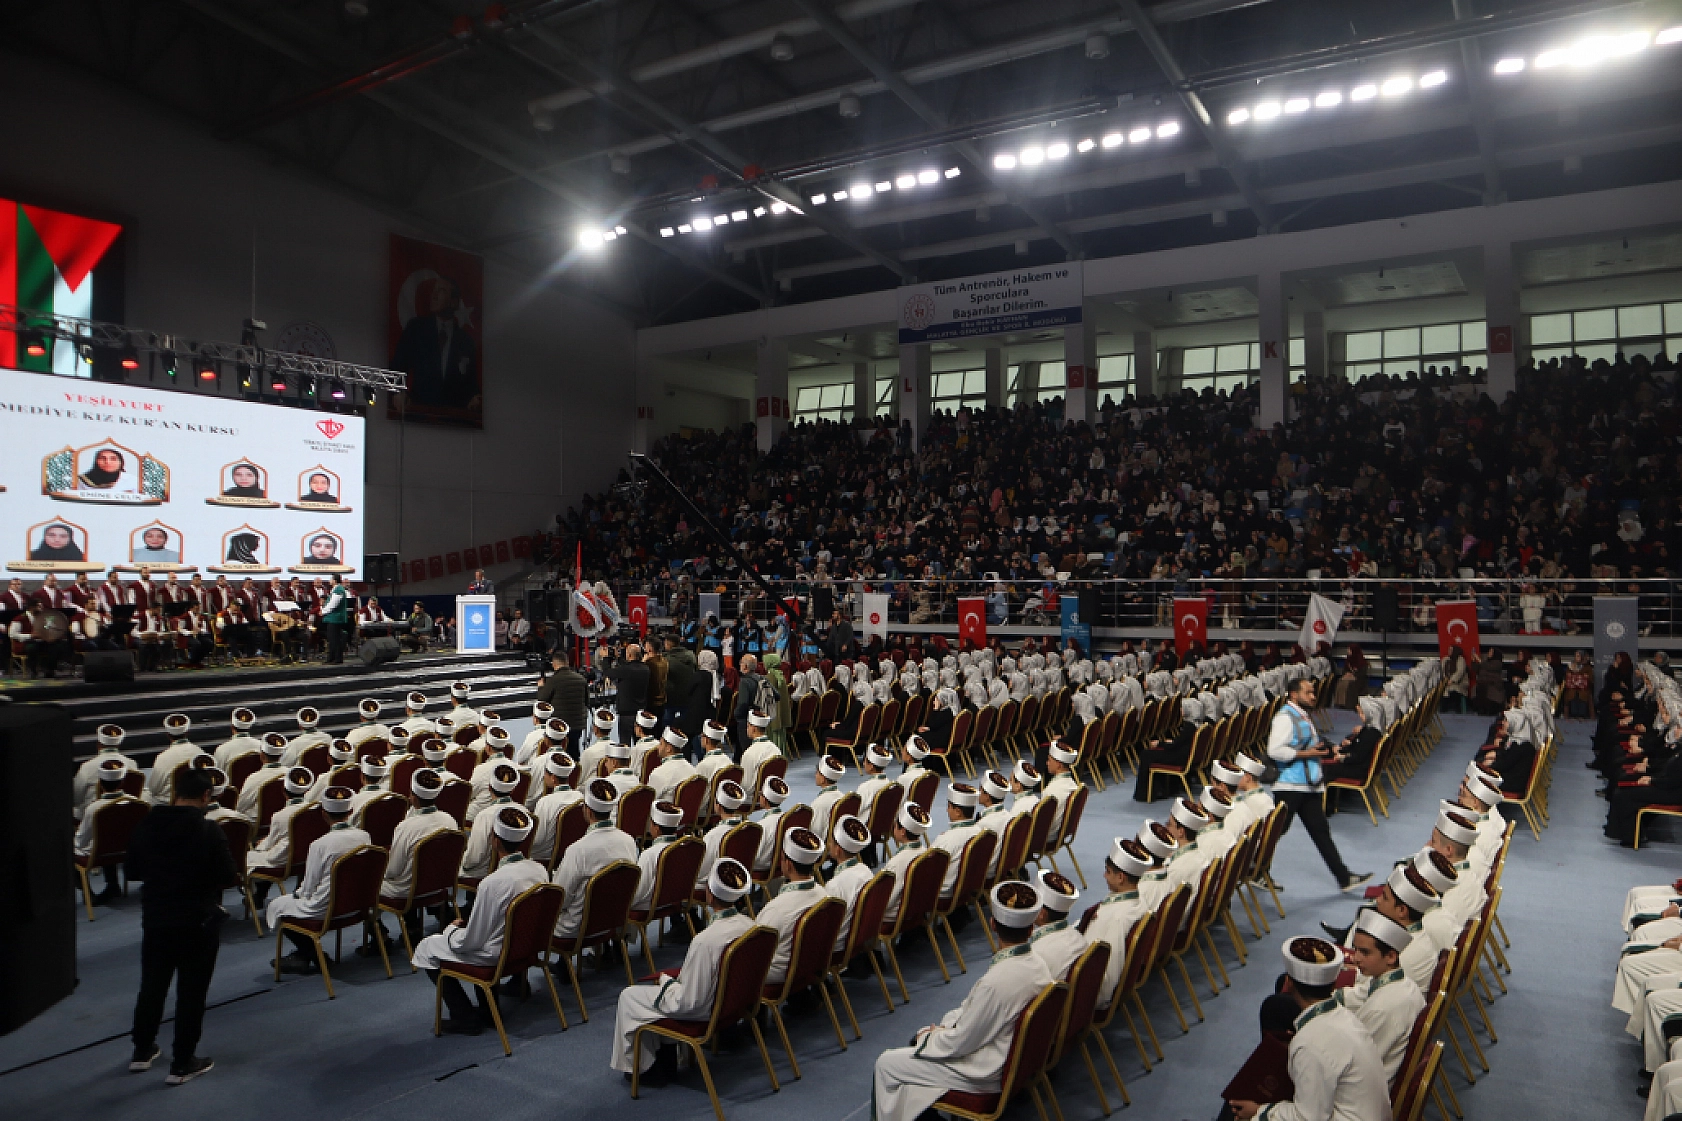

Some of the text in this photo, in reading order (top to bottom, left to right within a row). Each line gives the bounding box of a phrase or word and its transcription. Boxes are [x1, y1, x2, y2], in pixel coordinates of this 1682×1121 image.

[933, 269, 1069, 296] Tüm Antrenör, Hakem ve
[970, 286, 1029, 305] Sporculara
[952, 300, 1049, 320] Başarılar Dilerim.
[1264, 341, 1278, 359] K
[904, 377, 913, 393] L
[63, 392, 165, 413] YEŞİLYURT
[82, 411, 115, 423] KIZ
[186, 422, 239, 436] KURSU
